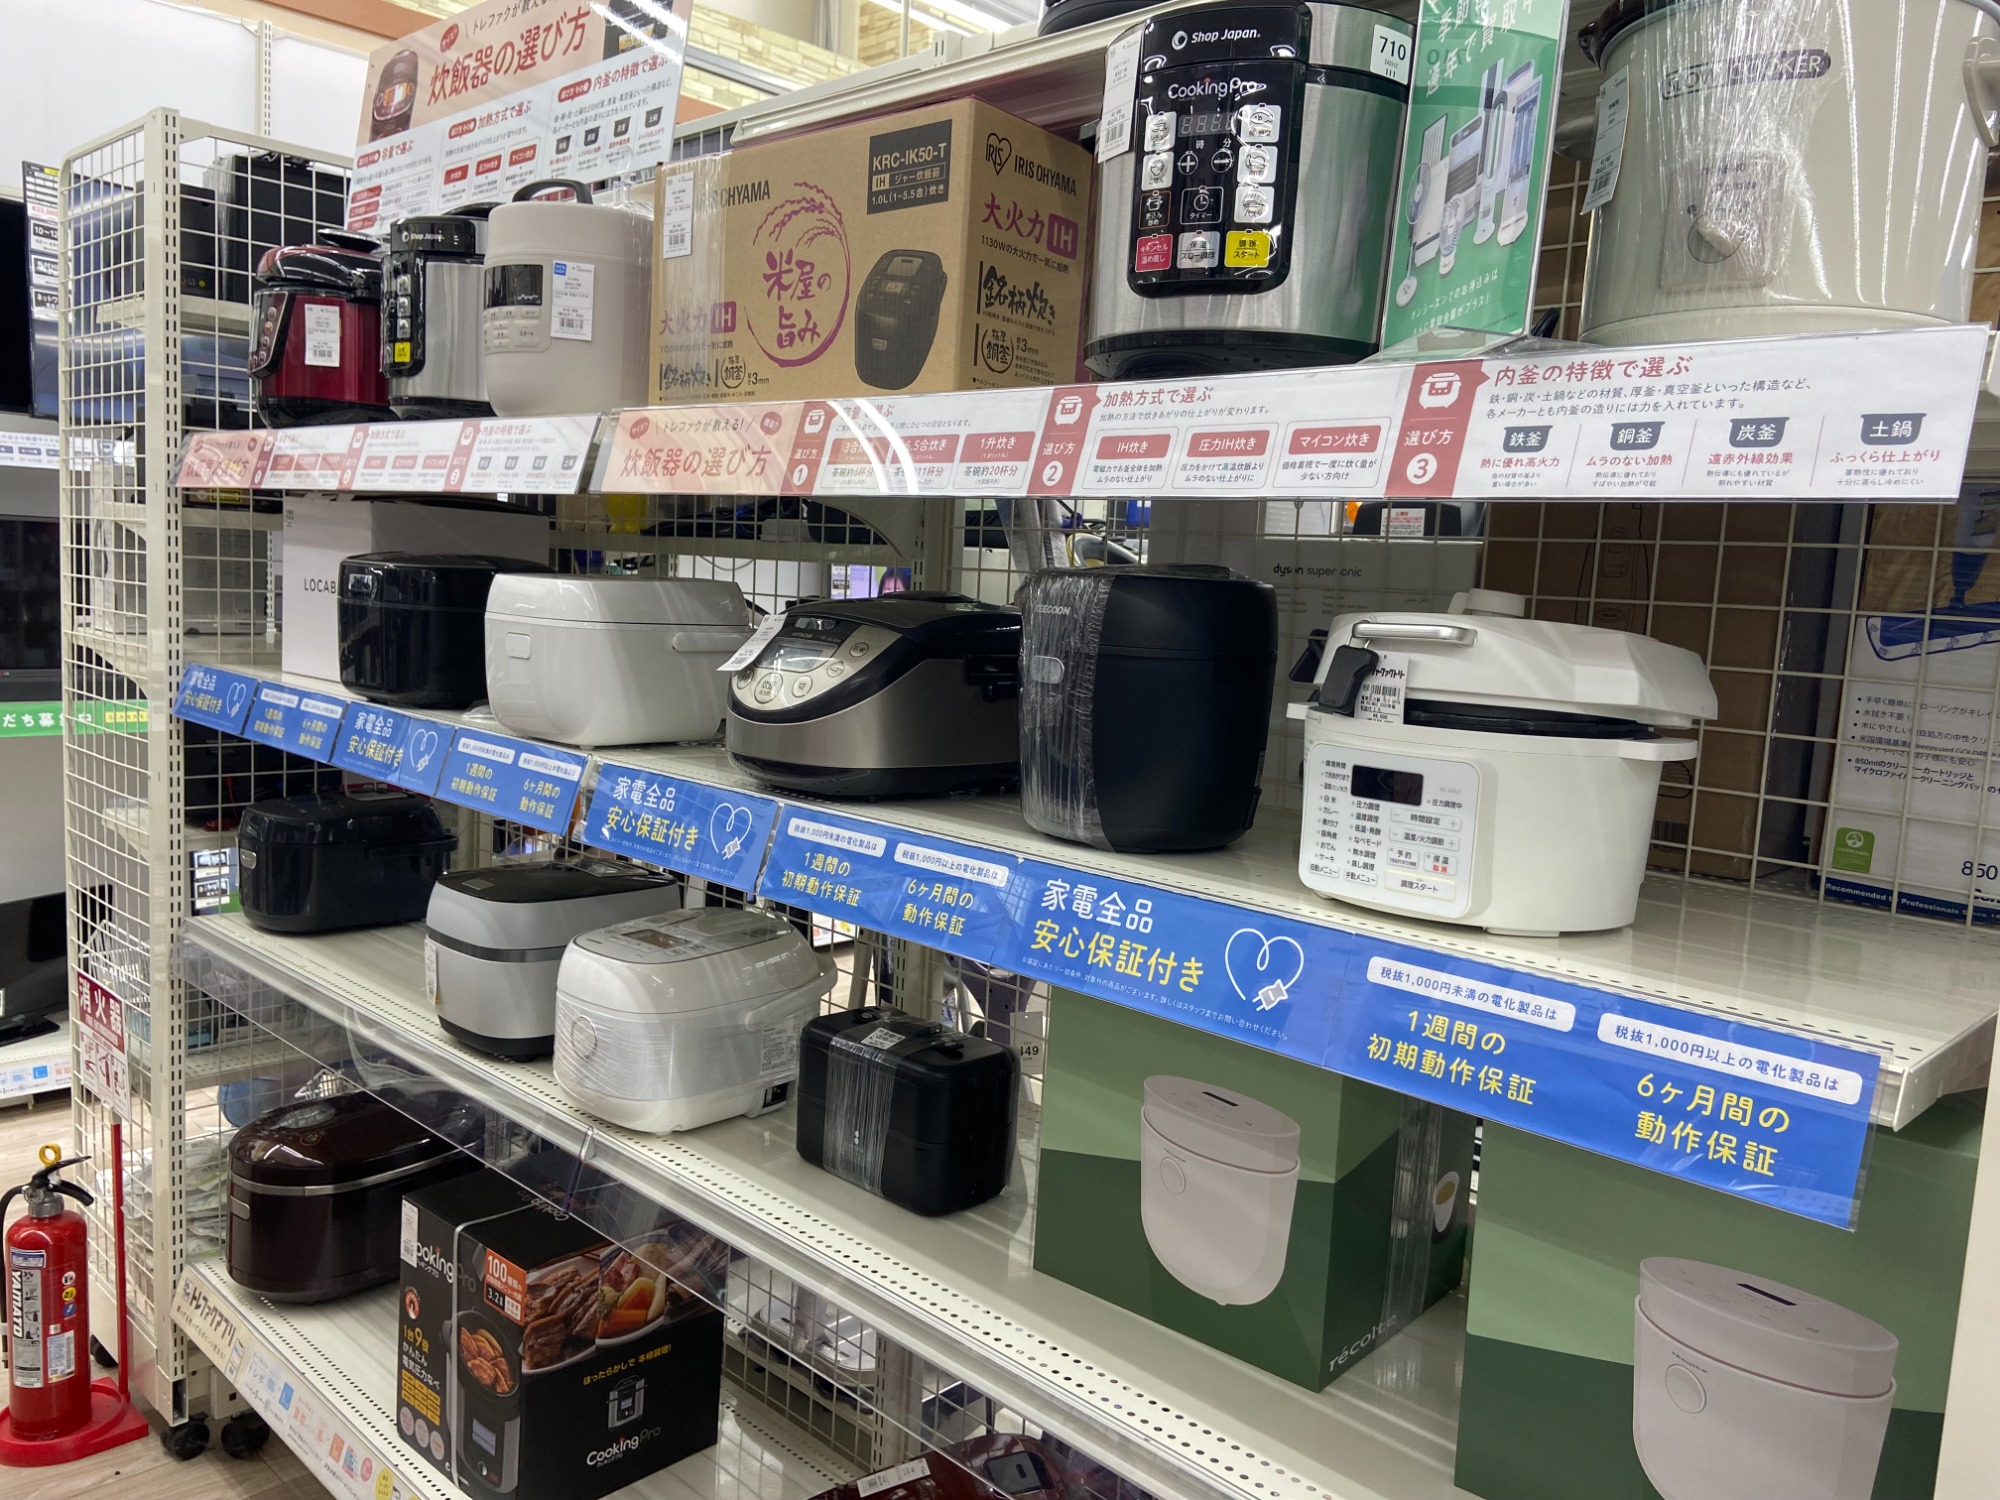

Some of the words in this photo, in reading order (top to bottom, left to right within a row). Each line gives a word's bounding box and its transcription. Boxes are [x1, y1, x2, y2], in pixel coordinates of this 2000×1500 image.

[1191, 30, 1221, 44] Shop
[1223, 28, 1257, 41] Japan
[428, 6, 590, 106] 炊飯器の選び方
[1380, 36, 1406, 61] 710
[593, 55, 668, 91] 内釜の特徴で選ぶ
[1168, 80, 1227, 99] Cooking
[1230, 77, 1258, 94] Pro
[477, 100, 533, 129] 加熱方式で選ぶ
[382, 140, 414, 162] 容量で選ぶ
[1195, 140, 1204, 149] 時
[1223, 138, 1231, 147] 分
[872, 143, 947, 171] KRC-IK50-T
[985, 142, 1004, 167] IRIS
[876, 177, 886, 188] IH
[895, 166, 940, 185] ジャー炊飯器
[1014, 155, 1035, 179] IRIS
[1036, 166, 1077, 196] OHYAMA
[981, 192, 1045, 244] 大火力
[1053, 222, 1073, 252] IH
[981, 235, 1069, 274] 1130Wの大火力で一気に加熱
[1141, 254, 1166, 263] 温め直し
[1180, 252, 1215, 261] スロー調理
[1233, 250, 1260, 259] スタート
[763, 248, 831, 302] 米屋の
[983, 265, 1056, 326] 銘柄炊き
[715, 306, 732, 331] IH
[777, 305, 821, 349] 旨み
[986, 341, 1011, 365] 銅釜
[1021, 338, 1039, 356] 3mm
[1494, 356, 1693, 387] 内釜の特徴で選ぶ
[1103, 386, 1214, 408] 加熱方式で選ぶ
[1489, 378, 1812, 404] 鉄・銅・炭・土鍋などの材質、厚釜・真空釜といった構造など、
[1100, 405, 1269, 422] 加熱の方法で炊きあがりの仕上がりが変わります。
[1486, 398, 1745, 420] 各メーカーとも内釜の造りには力を入れています。
[663, 417, 743, 433] トレファクが教える!
[1736, 424, 1776, 442] 炭釜
[1869, 420, 1913, 438] 土鍋
[980, 436, 1017, 450] 1升炊き
[1300, 432, 1370, 448] マイコン炊き
[1404, 429, 1454, 446] 選び方
[1509, 431, 1541, 447] 鉄釜
[1617, 427, 1653, 444] 銅釜
[793, 448, 818, 459] 選び方
[1042, 442, 1075, 456] 選び方
[1117, 441, 1149, 454] IH炊き
[1199, 437, 1257, 453] 圧力IH炊き
[620, 445, 772, 478] 炊飯器の選び方
[1282, 458, 1377, 470] 価格重視で一度に炊く量が
[1480, 456, 1560, 469] 熱に優れ高火力
[1585, 453, 1673, 466] ムラのない加熱
[1707, 452, 1794, 466] 遠赤外線効果
[1830, 450, 1941, 464] ふっくら仕上がり
[964, 465, 1018, 478] 茶碗約20杯分
[1047, 465, 1058, 483] 2
[1093, 464, 1163, 473] 電磁力でお釜全体を加熱
[1180, 462, 1264, 472] 圧力をかけて高温炊飯より
[1413, 458, 1429, 479] 3
[1595, 471, 1657, 479] 熱伝導に優れており
[1706, 469, 1790, 478] 熱伝導にも優れているが
[1845, 467, 1919, 476] 蓄熱性に優れており
[1097, 475, 1152, 484] ムラのない仕上がり
[1184, 474, 1254, 483] ムラのない仕上がりに
[1300, 472, 1350, 482] 少ない方向け
[1491, 480, 1537, 488] 重い場合が多い
[1592, 480, 1657, 488] すばやい加熱が可能
[1717, 478, 1773, 487] 割れやすい材質
[1836, 478, 1924, 486] 十分に蒸らし冷めにくい
[354, 710, 394, 738] 家電全品
[347, 734, 405, 767] 安心保証付き
[465, 762, 493, 780] 1週間の
[451, 778, 498, 802] 初期動作保証
[613, 776, 676, 812] 家電全品
[519, 796, 555, 820] 動作保証
[1323, 807, 1339, 815] カレー
[1356, 800, 1380, 811] 圧力調理
[1432, 799, 1462, 809] 圧力調理中
[1355, 812, 1379, 823] 温度調理
[1411, 813, 1440, 825] 時間設定
[607, 806, 698, 851] 安心保証付き
[794, 823, 878, 851] 税抜1,000円未満の電化製品は
[1355, 824, 1381, 836] 低温・発酵
[1320, 841, 1336, 851] おでん
[1353, 836, 1381, 848] なべモード
[1319, 853, 1335, 863] ケーキ
[1397, 850, 1412, 859] 予約
[1433, 855, 1449, 865] 保温
[804, 851, 851, 877] 1週間の
[902, 849, 999, 880] 税抜1,000円以上の電化製品は
[1310, 863, 1338, 874] 自動メニュー
[1351, 860, 1375, 871] 蒸し調理
[1345, 871, 1376, 883] 手動メニュー
[782, 869, 862, 907] 初期動作保証
[1401, 880, 1438, 893] 調理スタート
[1040, 878, 1154, 935] 家電全品
[1826, 883, 1886, 901] Recommended
[1901, 898, 1959, 915] Professionals
[902, 903, 966, 937] 動作保証
[1030, 919, 1205, 993] 安心保証付き
[1380, 966, 1558, 1021] 税抜1,000円未満の電化製品は
[79, 976, 122, 1037] 消火器
[1408, 1010, 1507, 1056] 1週間の
[1614, 1024, 1839, 1093] 税抜1,000円以上の電化製品は
[1367, 1032, 1537, 1107] 初期動作保証
[1634, 1110, 1779, 1178] 動作保証
[488, 1255, 508, 1283] 100
[189, 1286, 236, 1347] トレファクアプリ
[404, 1325, 430, 1353] 1台9役
[1329, 1314, 1397, 1372] récolte
[403, 1341, 428, 1367] かんたん
[402, 1354, 440, 1390] 電気圧力なべ
[584, 1359, 636, 1386] ほったらかしで
[587, 1436, 639, 1466] Cooking
[640, 1427, 661, 1443] Pro
